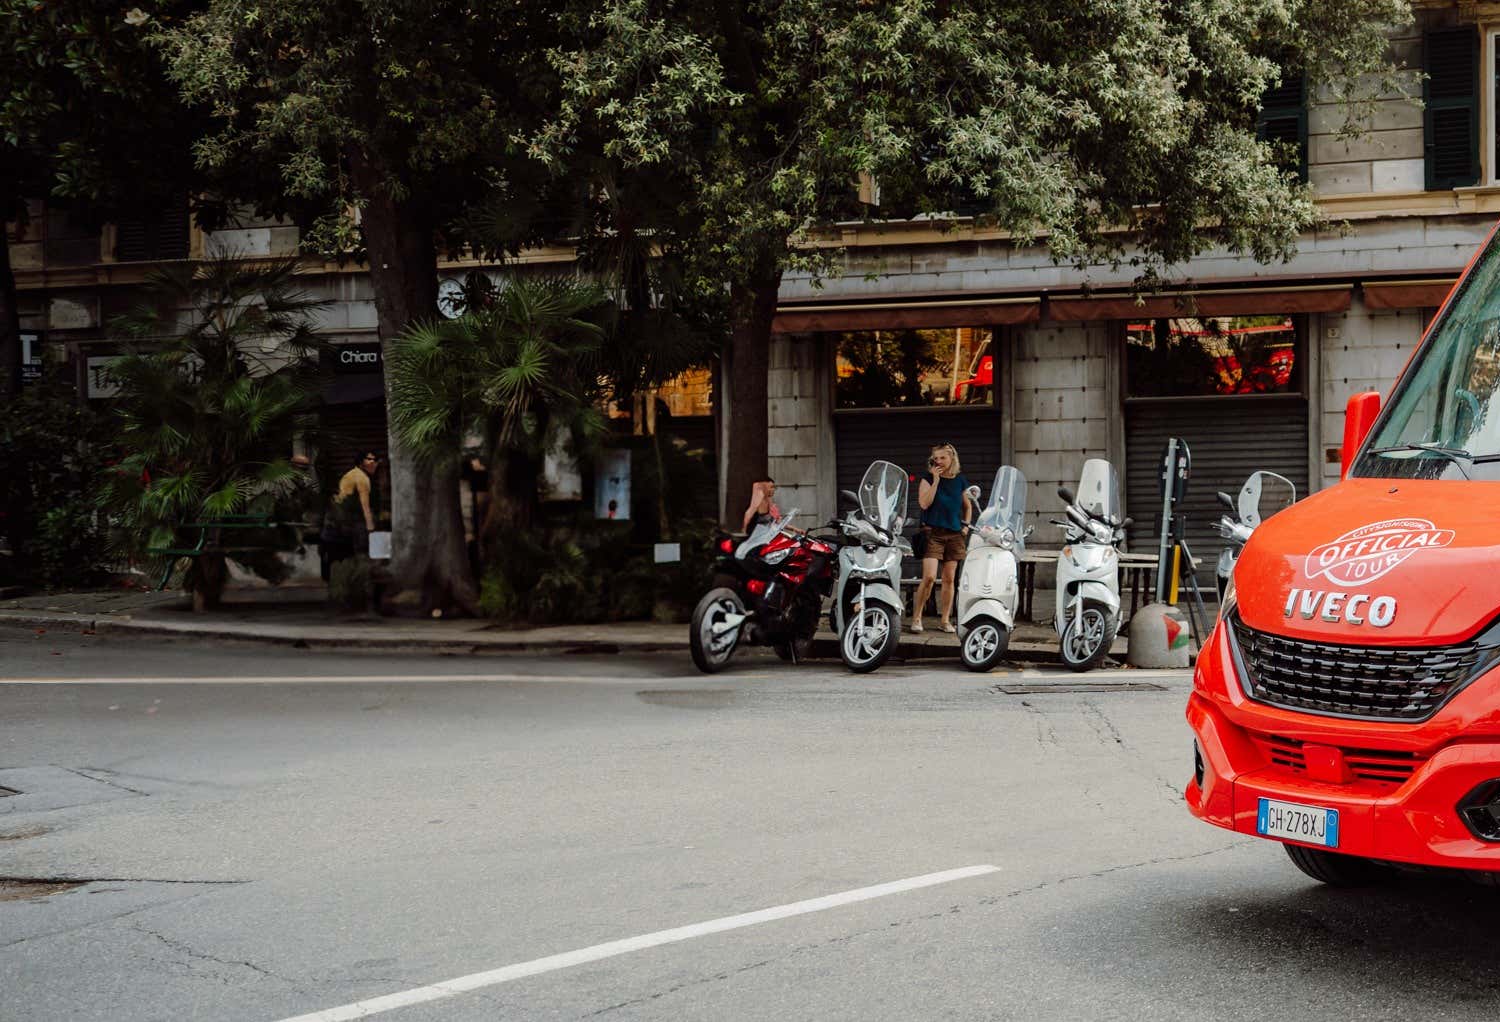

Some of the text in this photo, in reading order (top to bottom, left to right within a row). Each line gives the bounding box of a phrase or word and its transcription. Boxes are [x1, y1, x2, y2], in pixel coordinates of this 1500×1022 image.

[340, 350, 377, 363] Chiara
[1319, 532, 1442, 567] OFFICIAL
[1345, 553, 1401, 578] TOUR
[1284, 588, 1398, 628] IVECO
